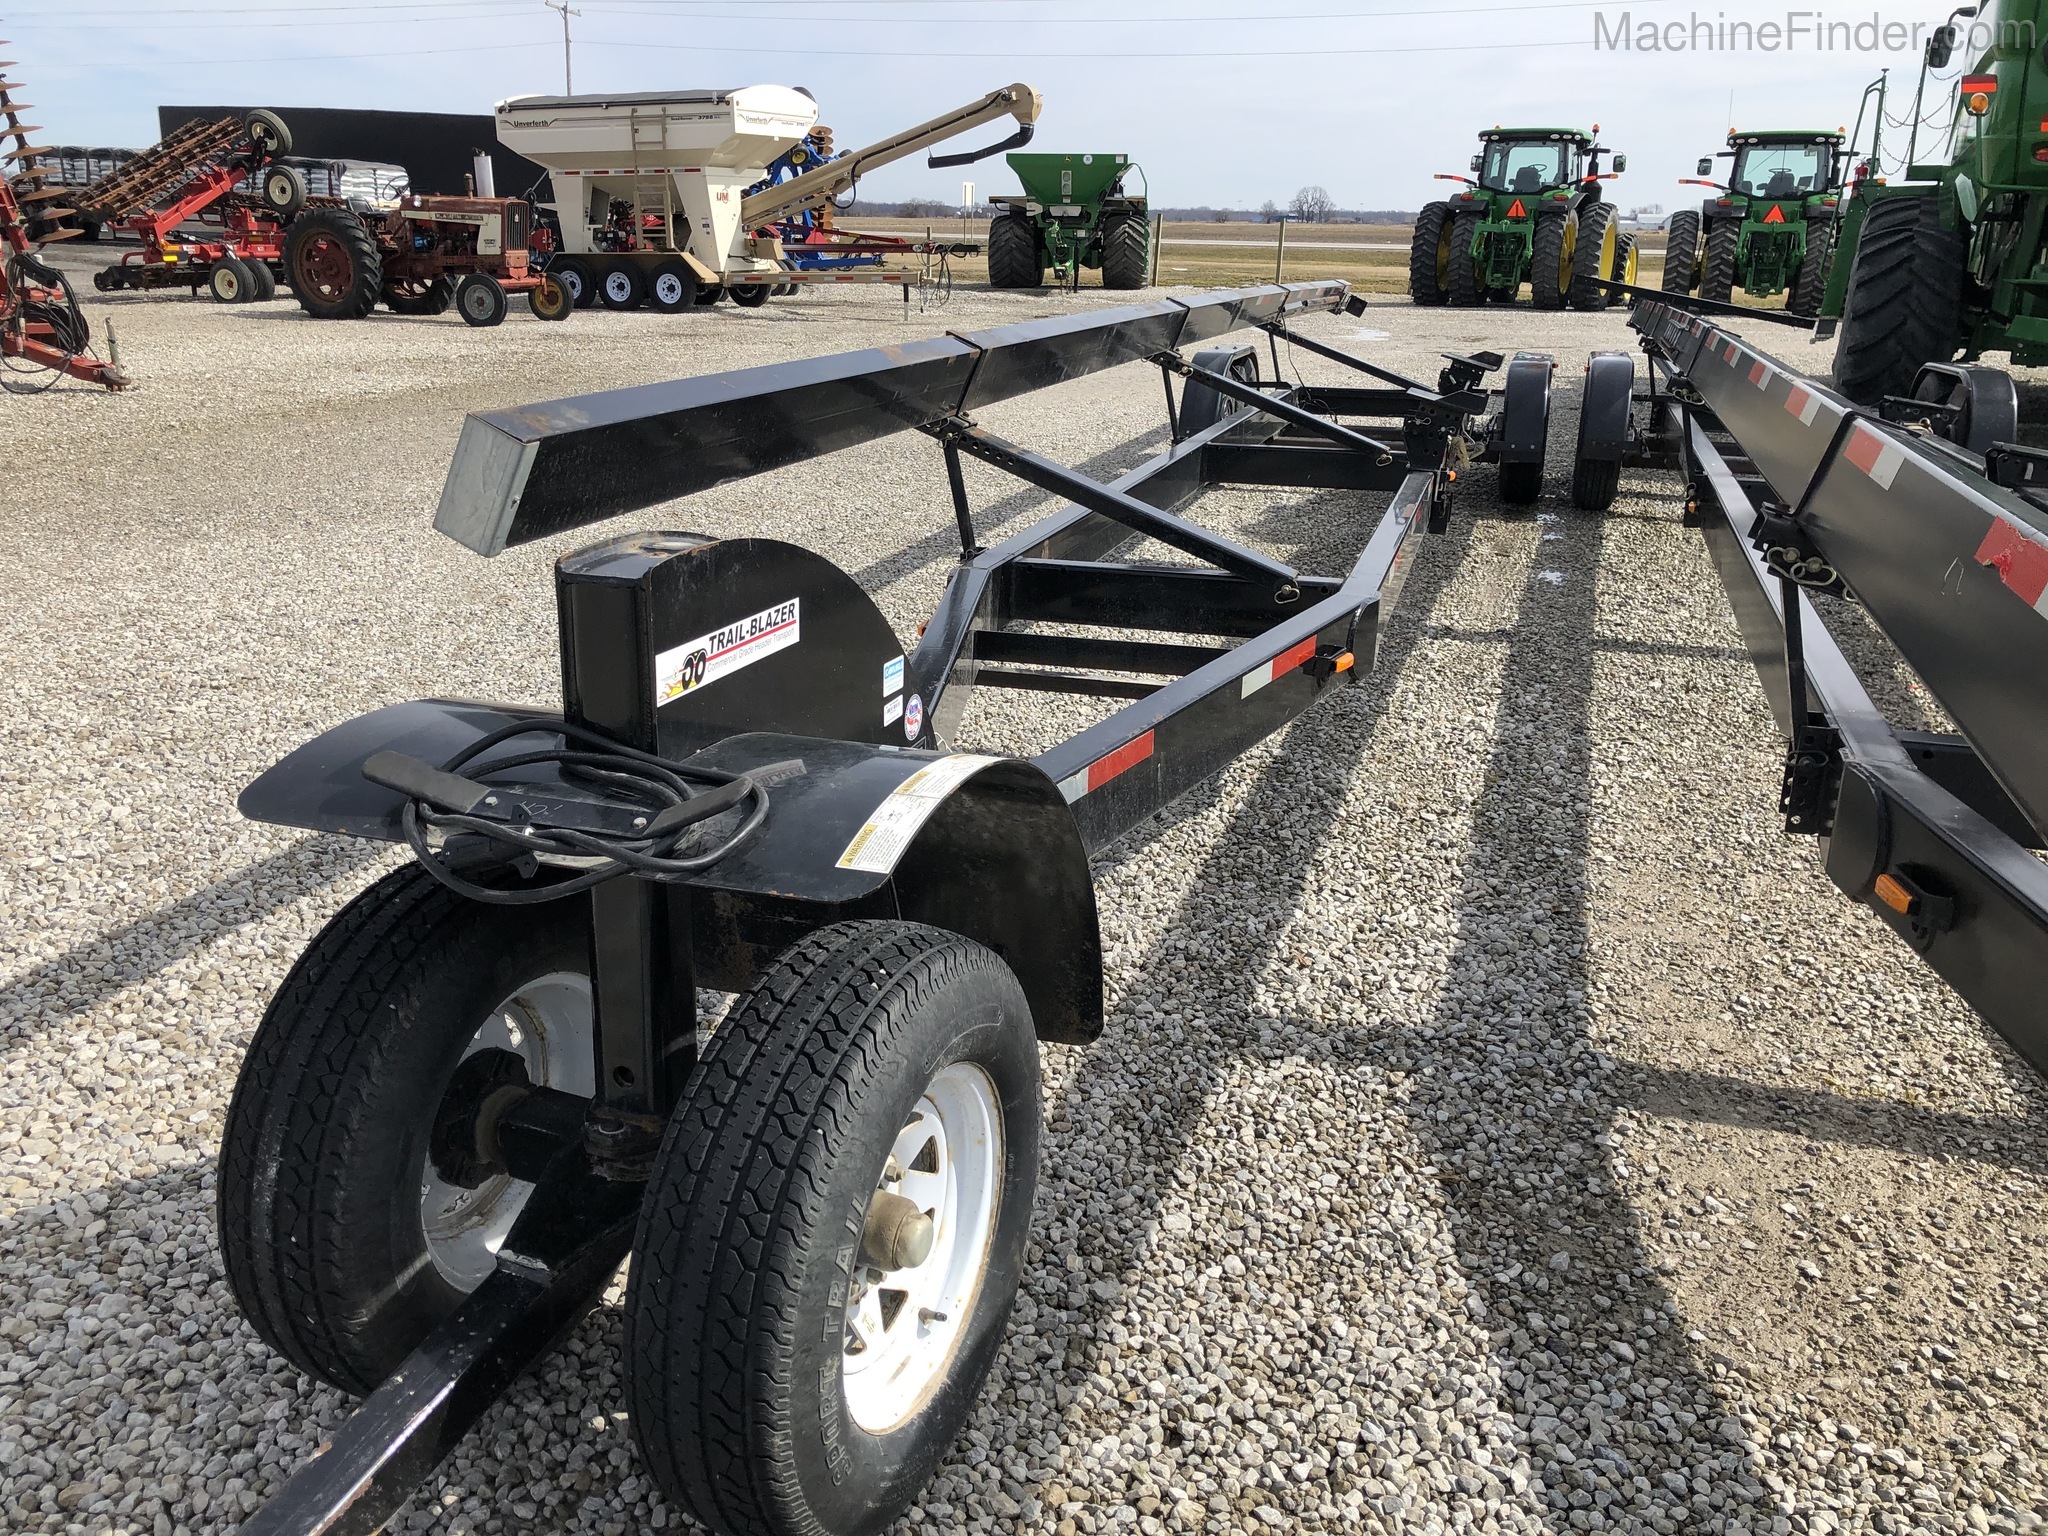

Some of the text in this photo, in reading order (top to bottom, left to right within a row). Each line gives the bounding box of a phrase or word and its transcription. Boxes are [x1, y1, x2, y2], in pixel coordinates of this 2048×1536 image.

[707, 627, 795, 673] Commercial Grade Header Transport
[709, 602, 795, 654] TRAIL-BLAZER
[849, 829, 873, 857] WARNING
[818, 1191, 869, 1487] SPORT TRAIL
